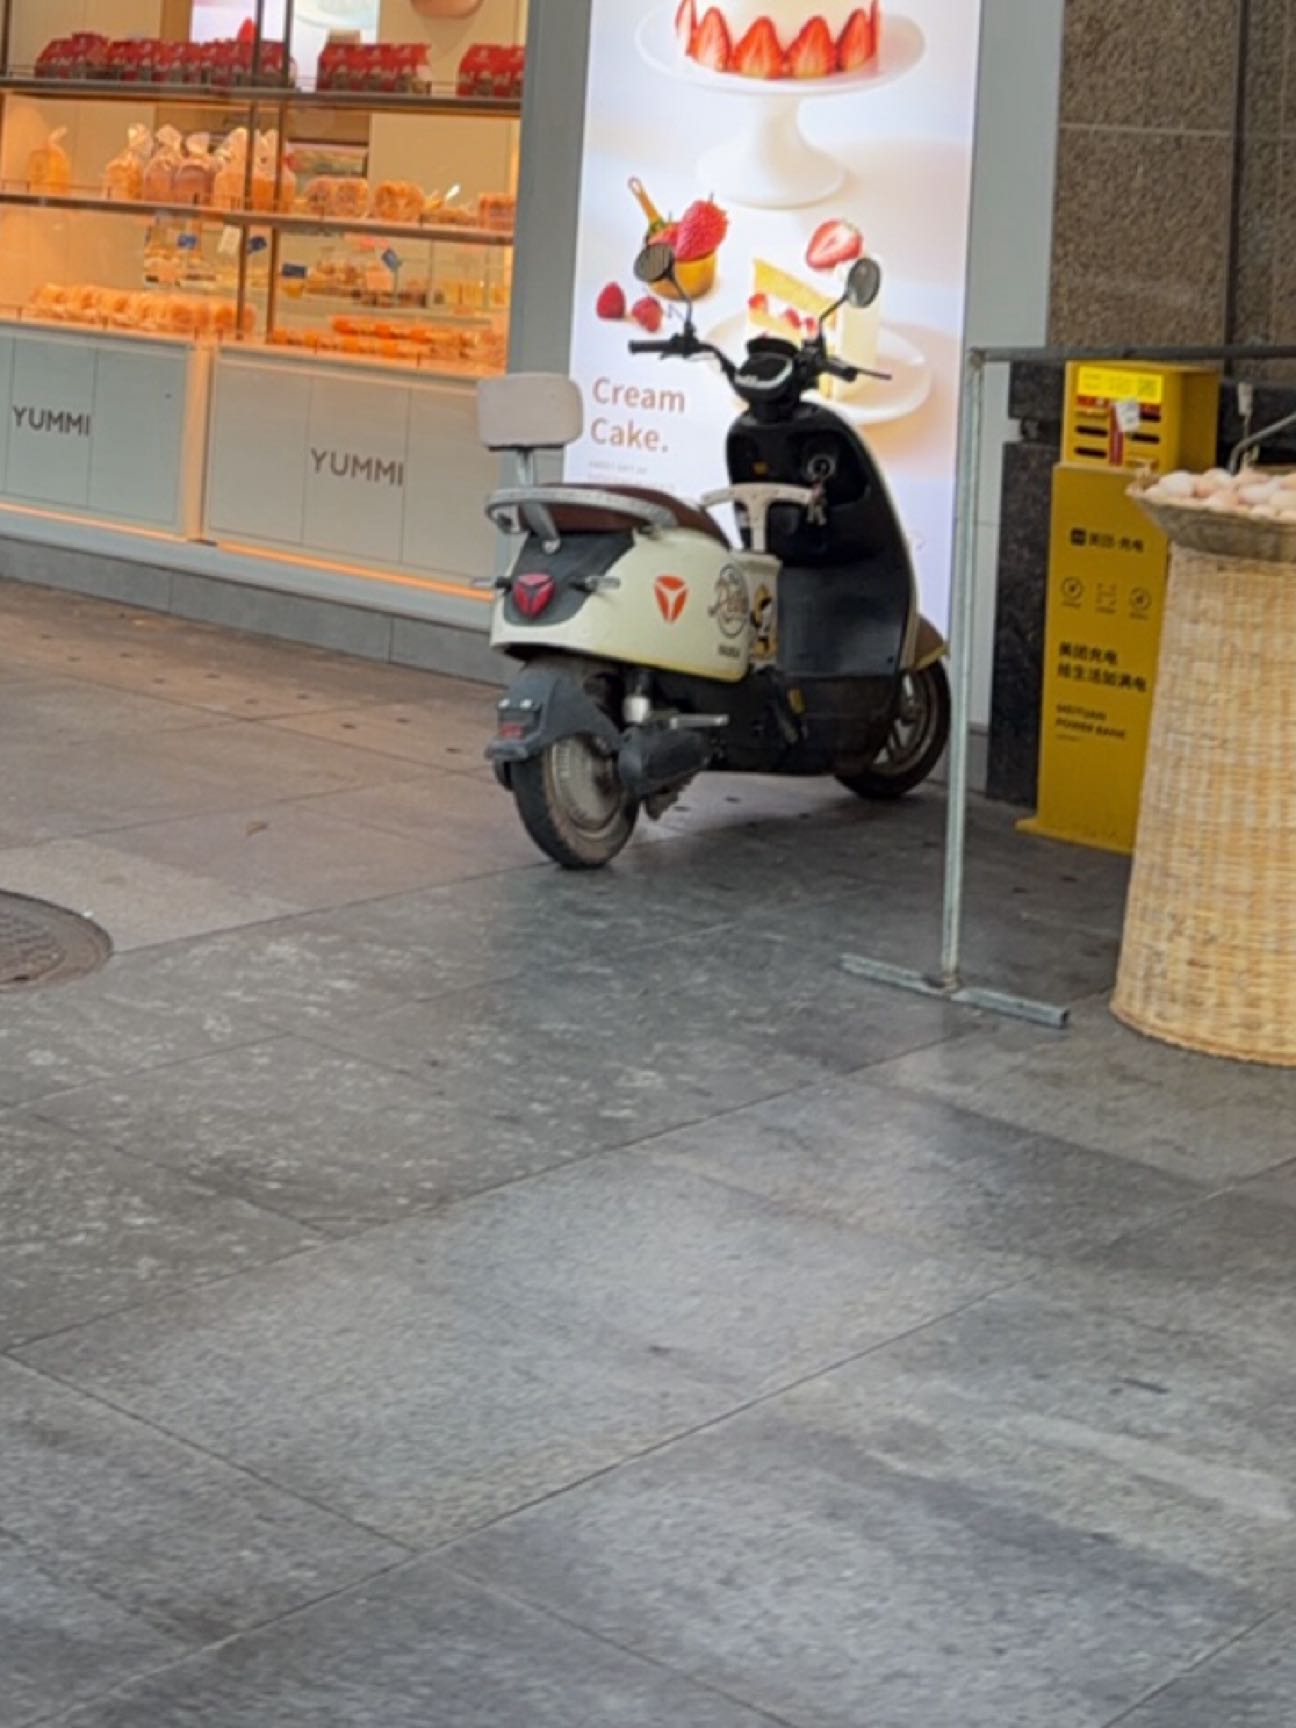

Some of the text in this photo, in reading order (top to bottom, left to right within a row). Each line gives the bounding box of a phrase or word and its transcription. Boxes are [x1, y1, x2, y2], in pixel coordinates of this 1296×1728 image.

[592, 376, 686, 413] Cream
[12, 405, 91, 436] YUMMI
[590, 417, 669, 454] Cake.
[310, 447, 404, 487] YUMMI
